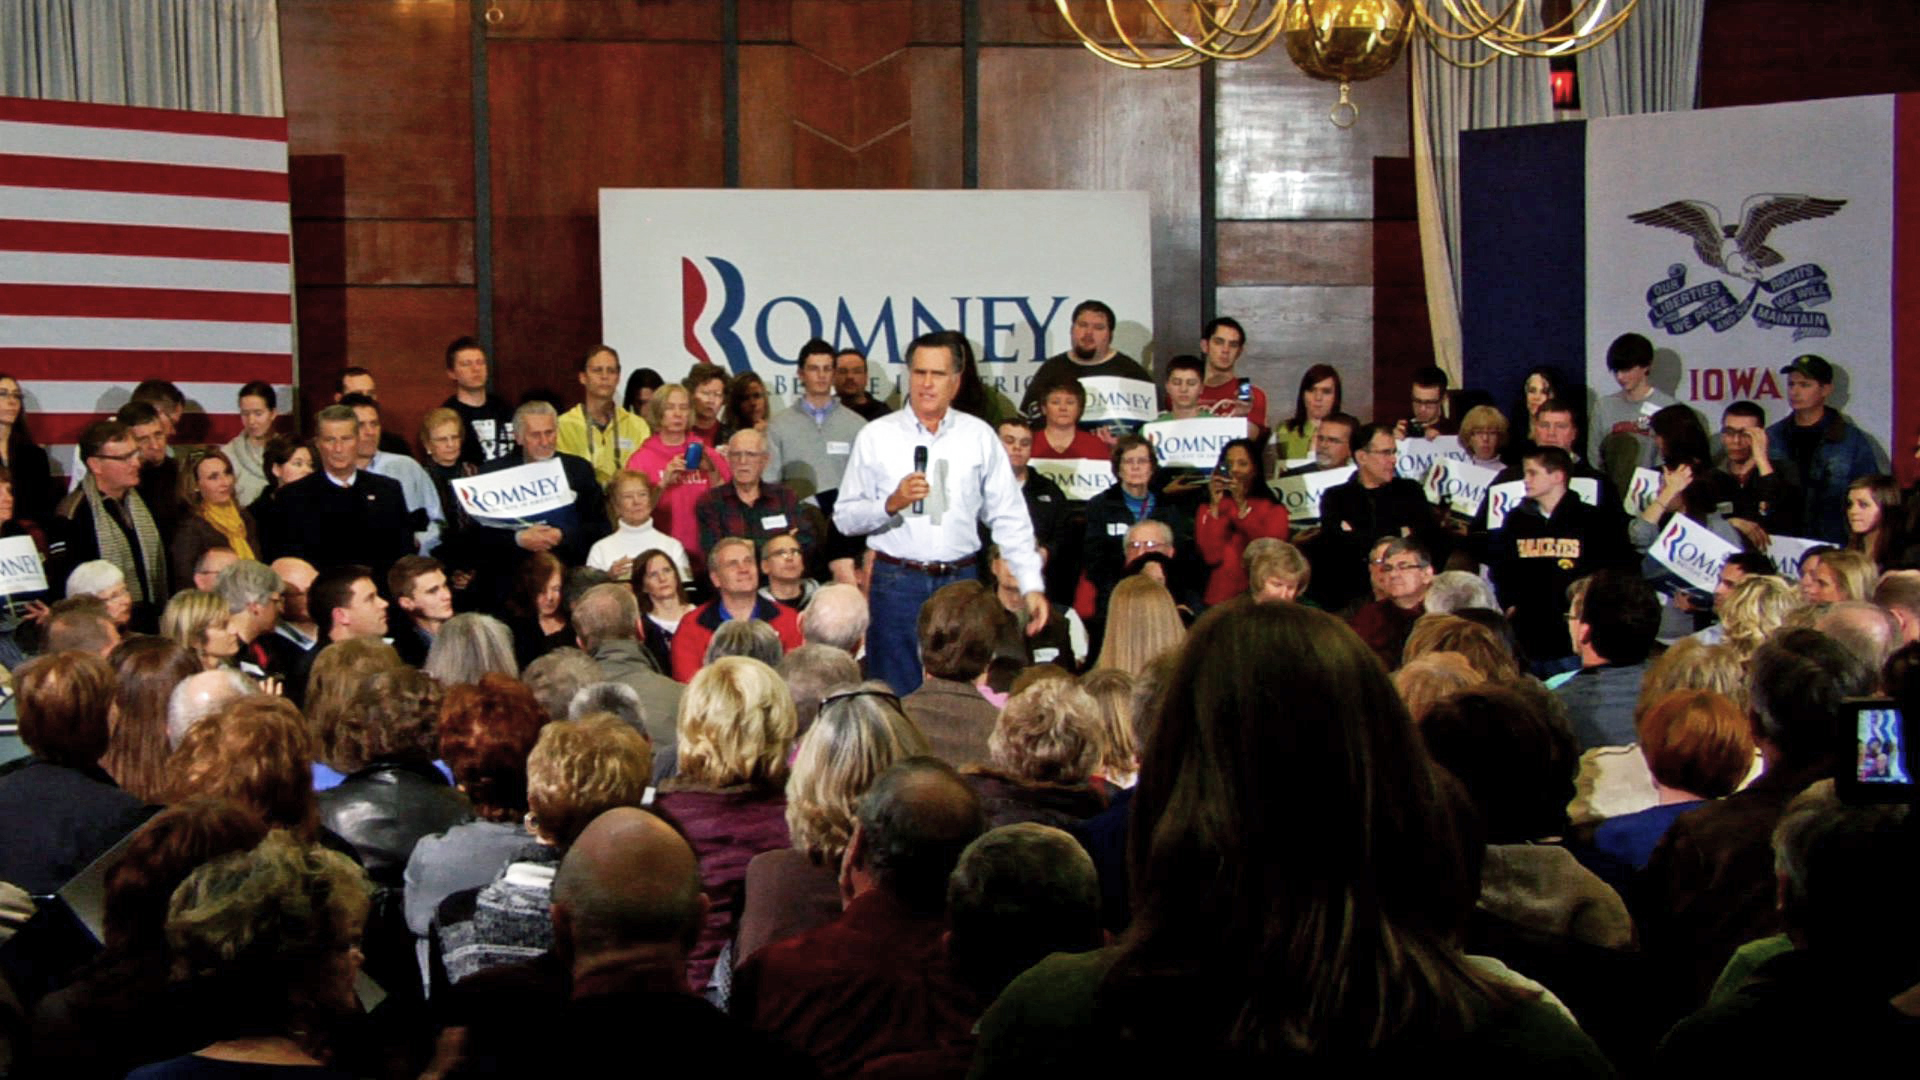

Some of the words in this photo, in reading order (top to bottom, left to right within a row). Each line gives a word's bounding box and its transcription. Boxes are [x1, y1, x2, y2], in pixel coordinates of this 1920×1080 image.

[1653, 279, 1679, 296] OUR
[1770, 266, 1814, 292] RIGHTS
[1654, 283, 1720, 318] LIBERTIES
[1776, 292, 1795, 309] WE
[1796, 284, 1825, 299] WILL
[682, 256, 1070, 373] ROMNEY
[1671, 316, 1693, 332] WE
[1694, 297, 1729, 322] PRIZE
[1757, 305, 1826, 326] MAINTAIN
[1689, 367, 1784, 401] IOWA
[460, 475, 560, 512] ROMNEY
